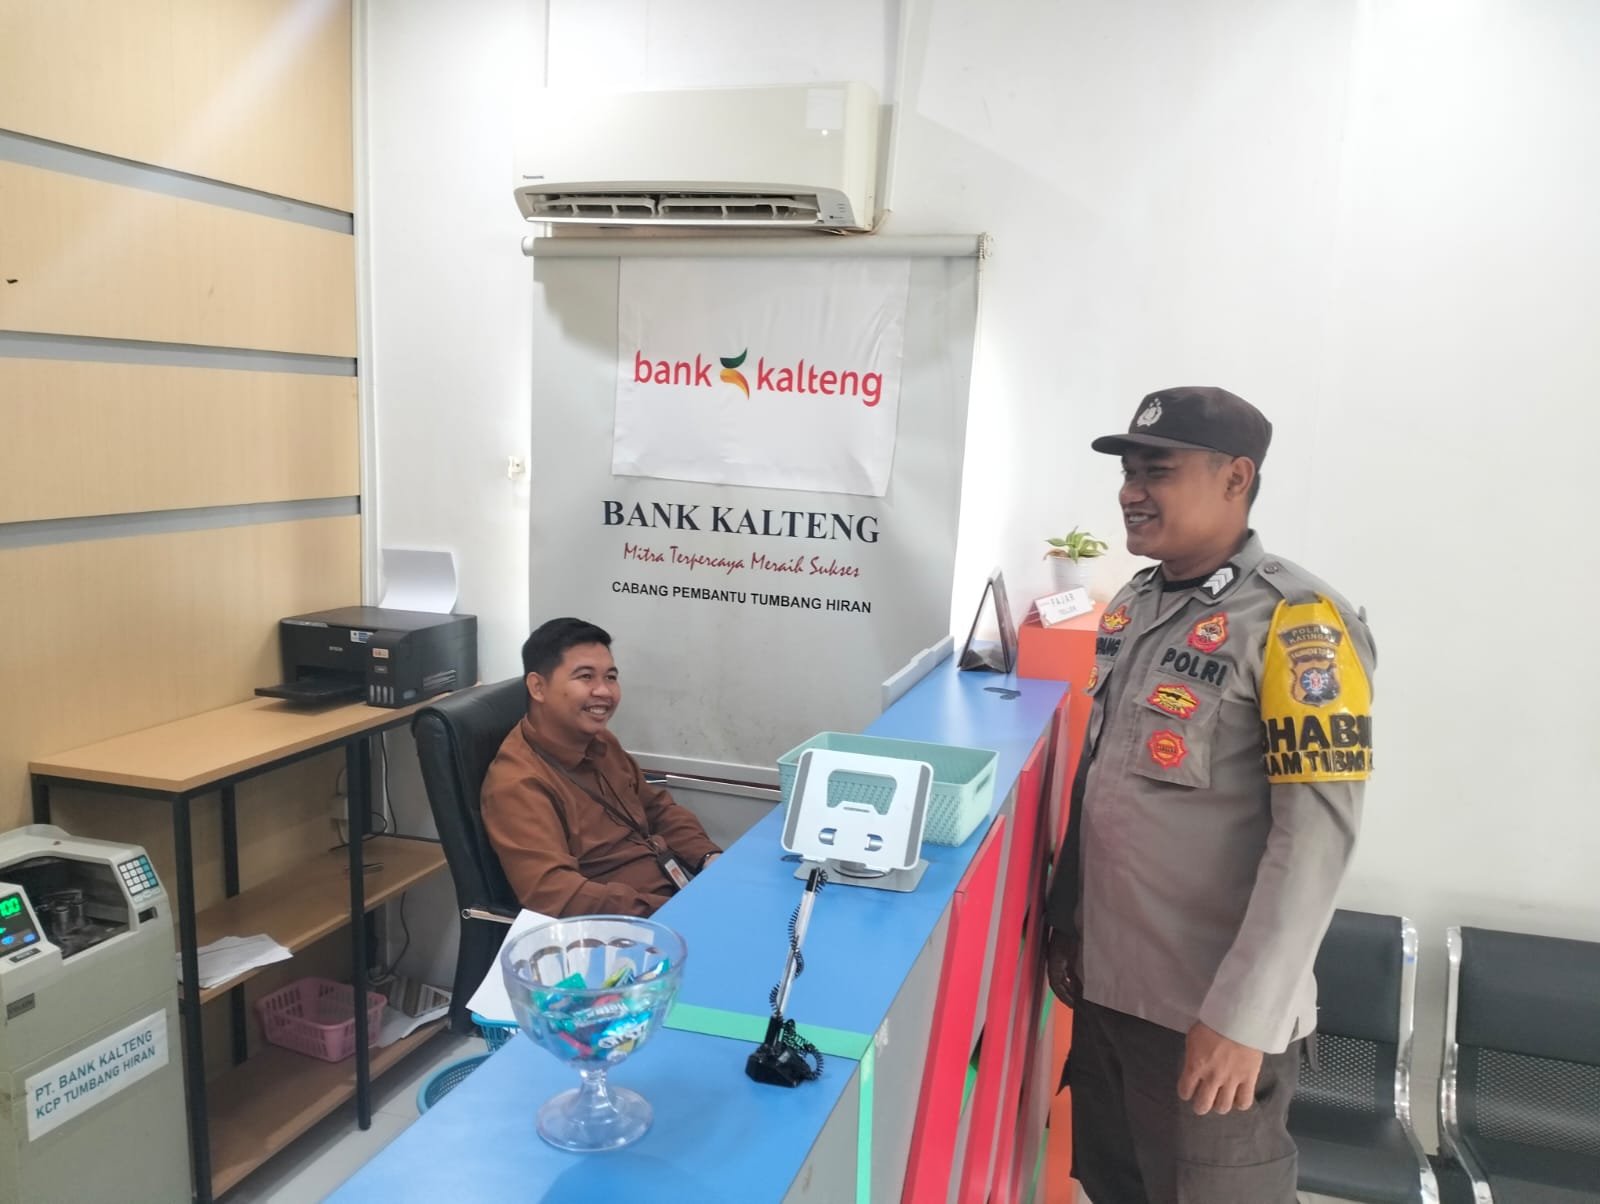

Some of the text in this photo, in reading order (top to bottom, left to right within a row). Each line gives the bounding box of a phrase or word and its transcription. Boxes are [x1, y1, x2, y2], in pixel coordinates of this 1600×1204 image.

[634, 350, 882, 407] bank kalteng
[601, 500, 880, 543] BANK KALTENG
[623, 542, 860, 578] Mitra Terpercaya Meraih Sukses
[612, 581, 871, 614] CABANG PEMBANTU TUMBANG HIRAN
[1160, 647, 1228, 686] POLRI
[35, 1030, 153, 1102] PT. BANK KALTENG
[35, 1046, 156, 1119] KCP TUMBANG HIRAN
